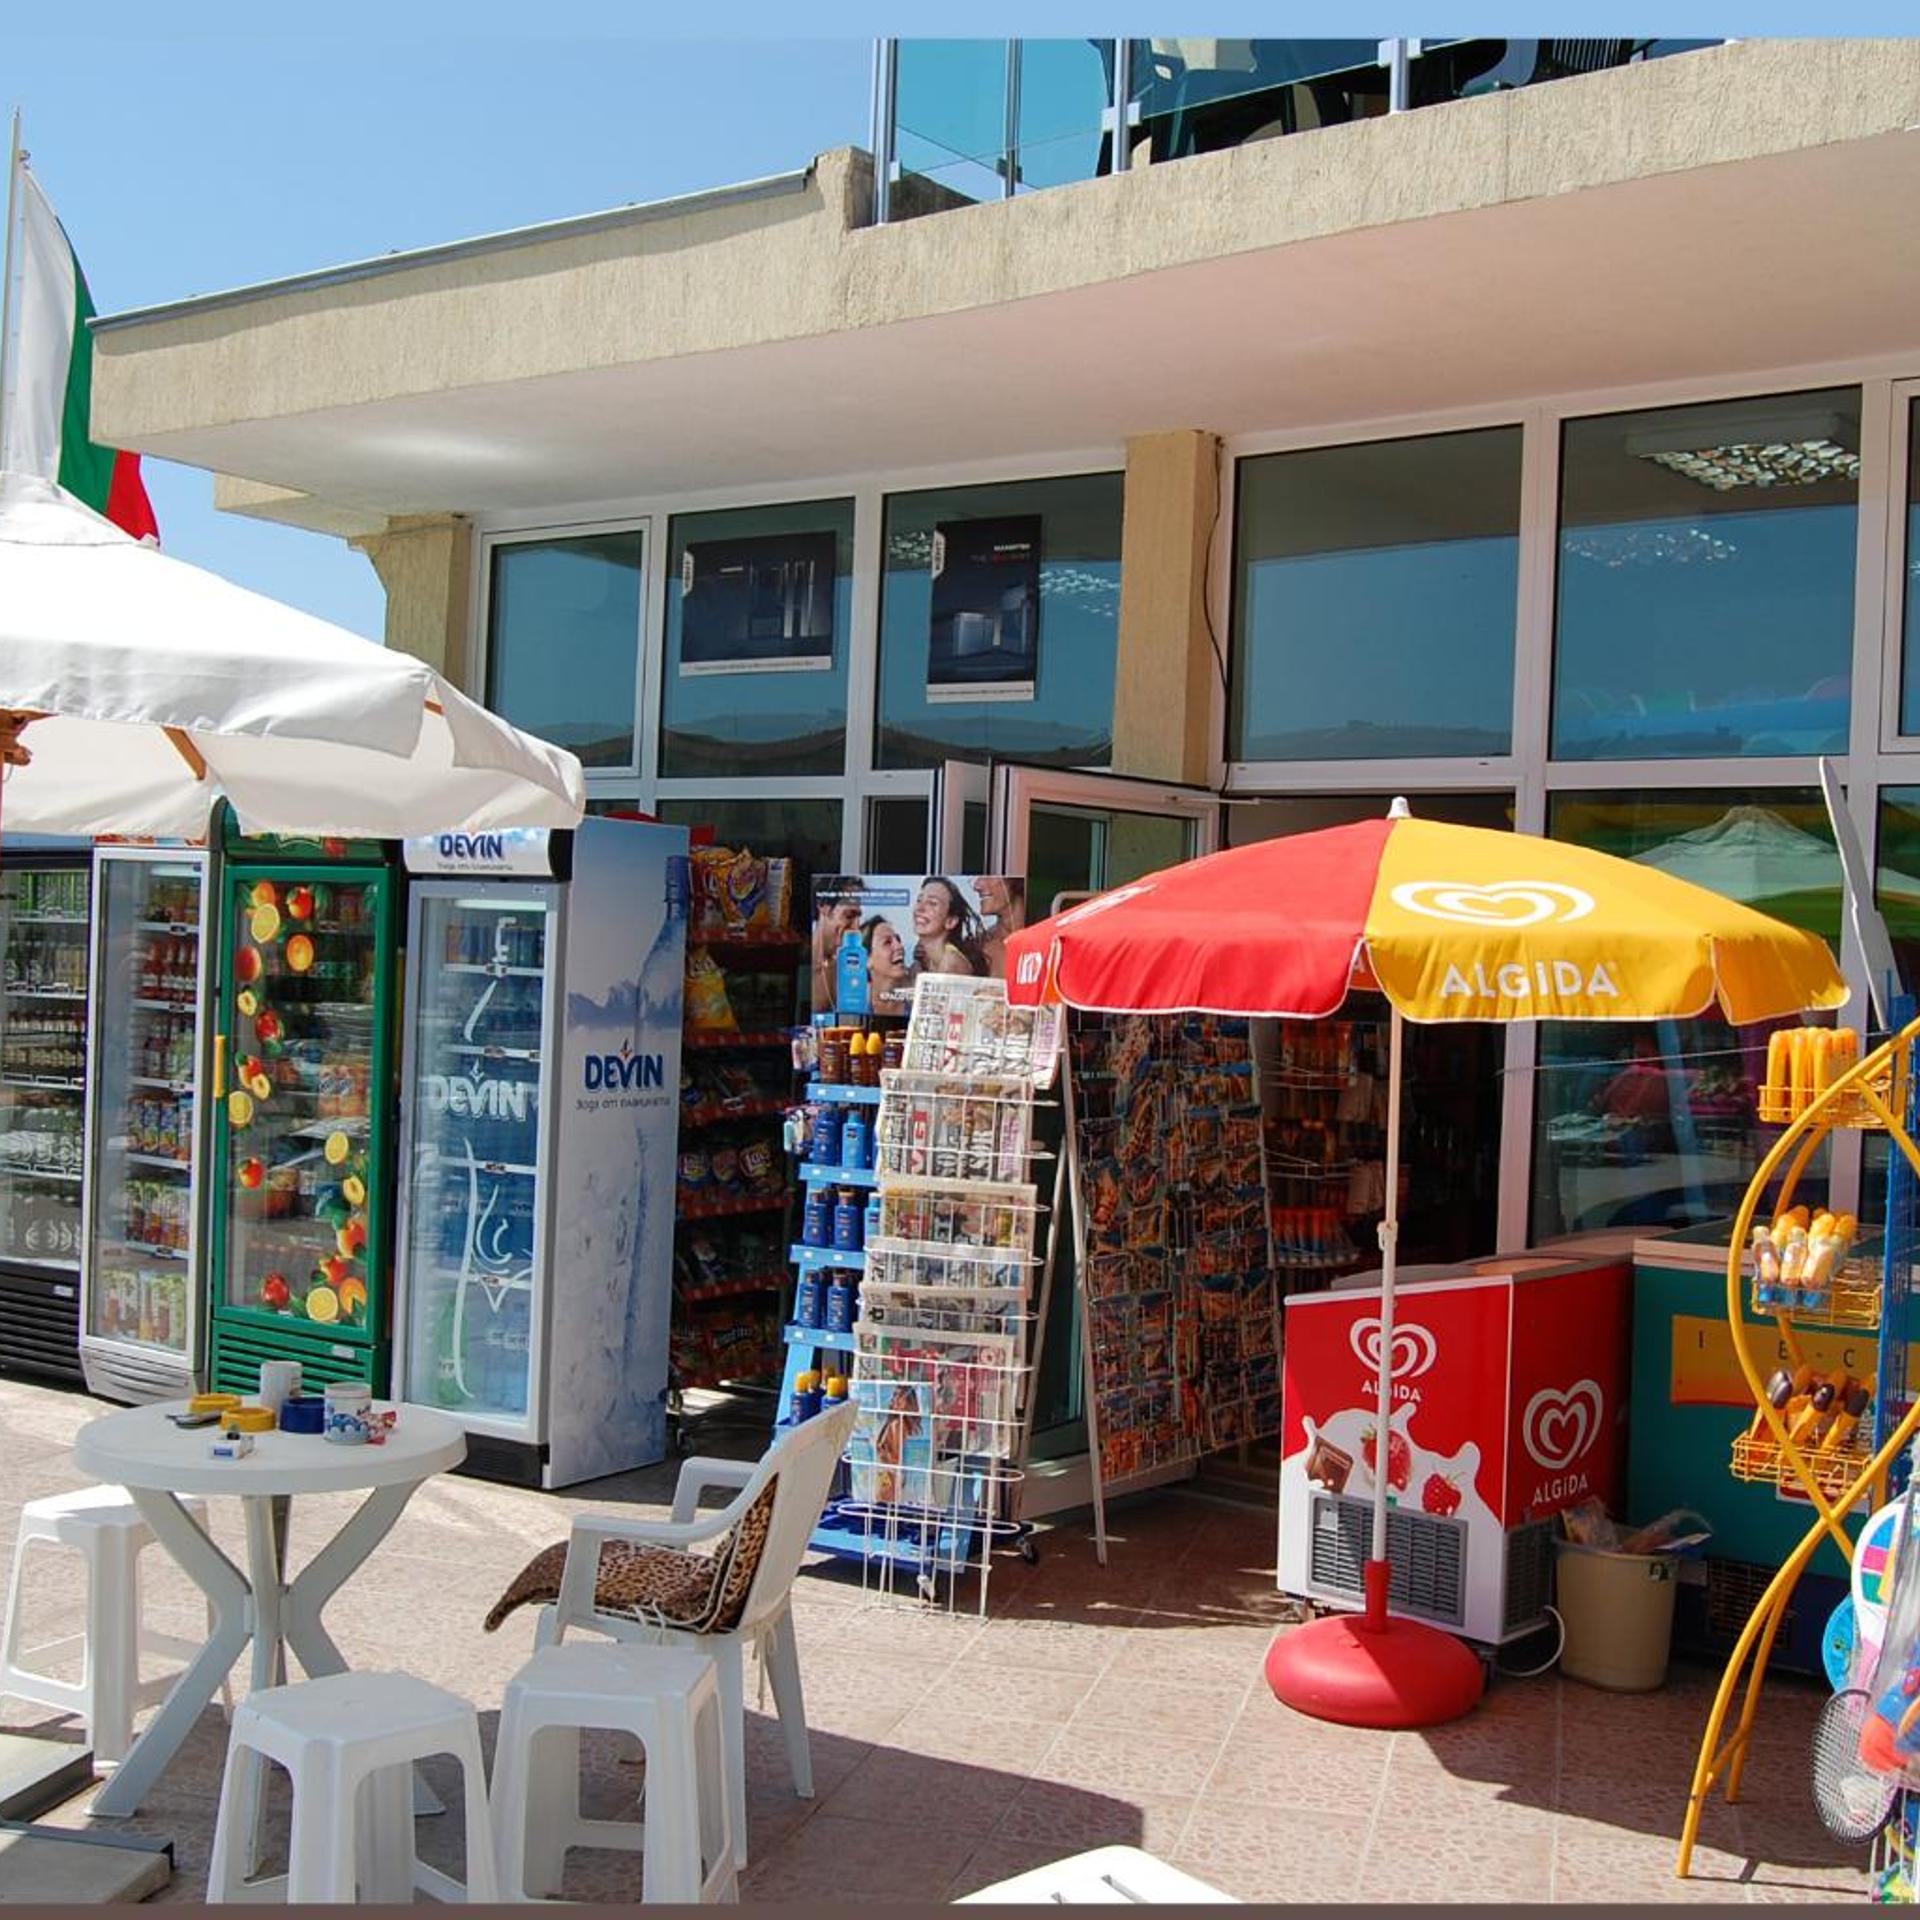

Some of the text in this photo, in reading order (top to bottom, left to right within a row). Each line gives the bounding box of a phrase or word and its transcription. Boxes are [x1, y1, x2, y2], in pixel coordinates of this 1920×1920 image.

[439, 834, 503, 858] DEVIN
[1440, 960, 1618, 998] ALGIDA
[584, 1054, 663, 1090] DEVIN
[423, 1075, 528, 1122] DEVIN
[1361, 1379, 1421, 1402] ALIDA
[1532, 1473, 1589, 1506] ALGIDA
